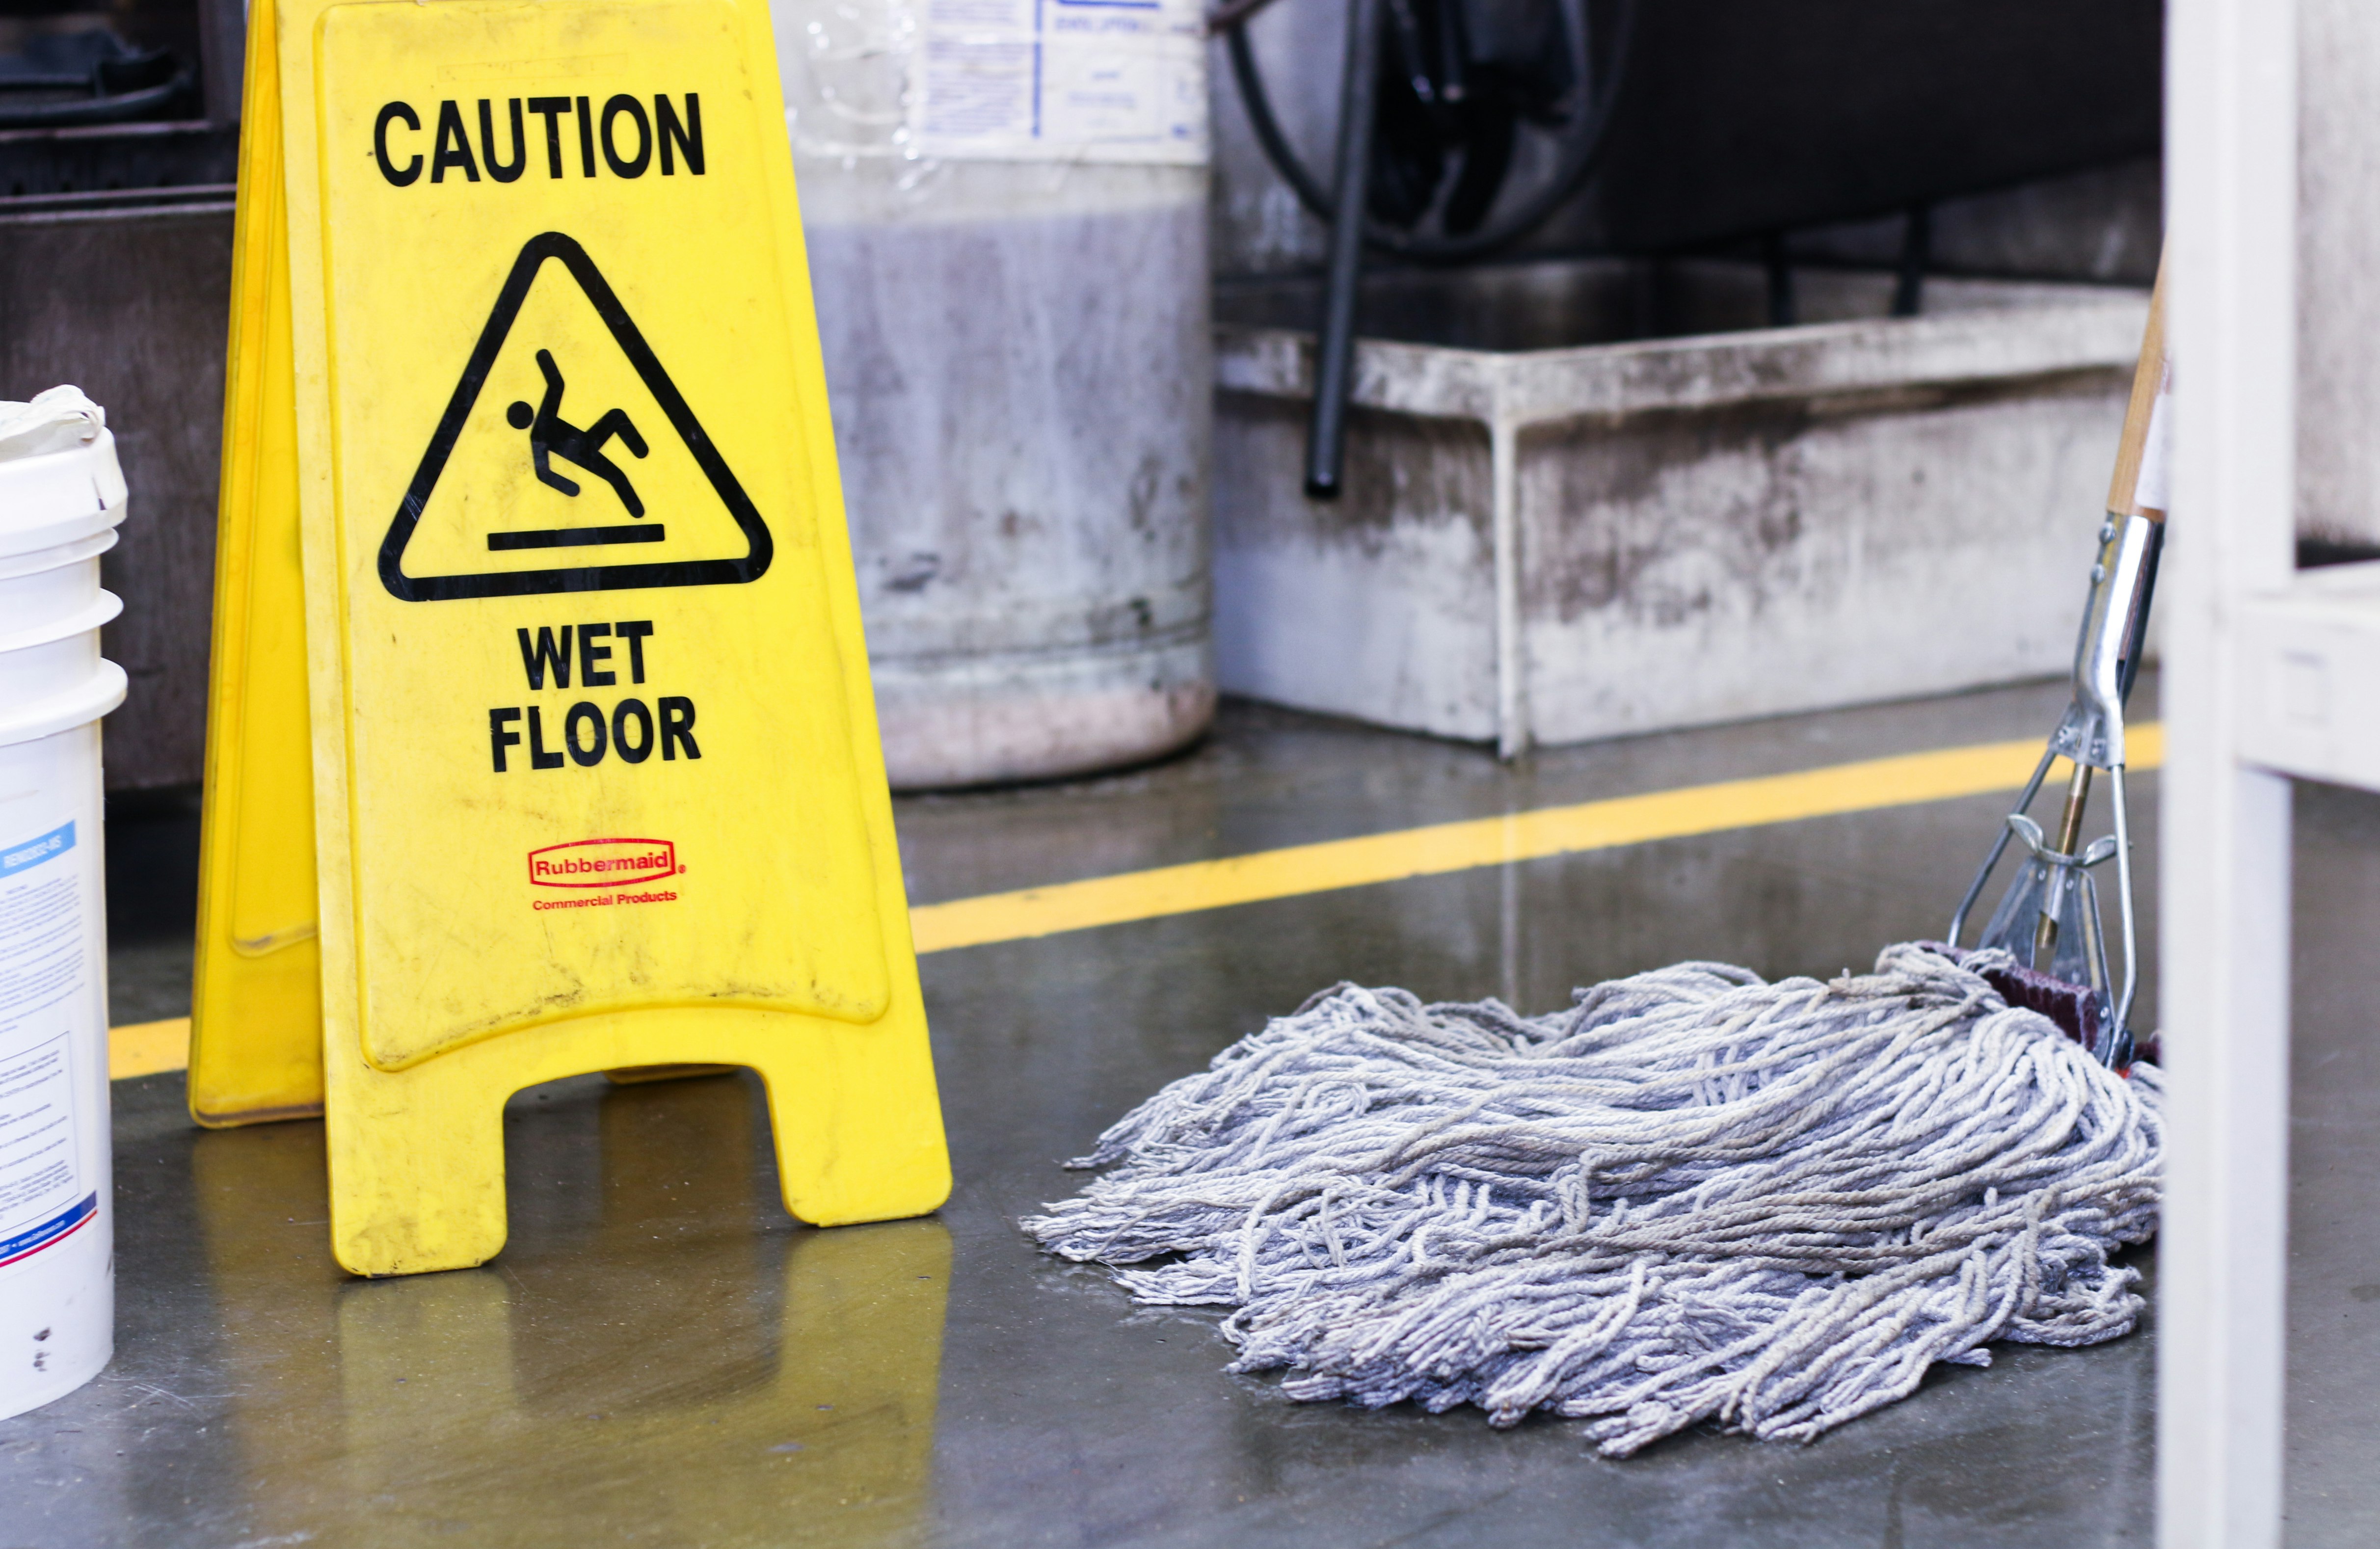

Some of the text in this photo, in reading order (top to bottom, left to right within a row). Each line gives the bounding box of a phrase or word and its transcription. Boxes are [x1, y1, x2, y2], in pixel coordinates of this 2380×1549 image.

[374, 92, 705, 187] CAUTION
[516, 620, 654, 691] WET
[489, 695, 702, 773] FLOOR
[535, 851, 668, 876] Rubbermaid
[533, 890, 677, 910] Commercial Products
